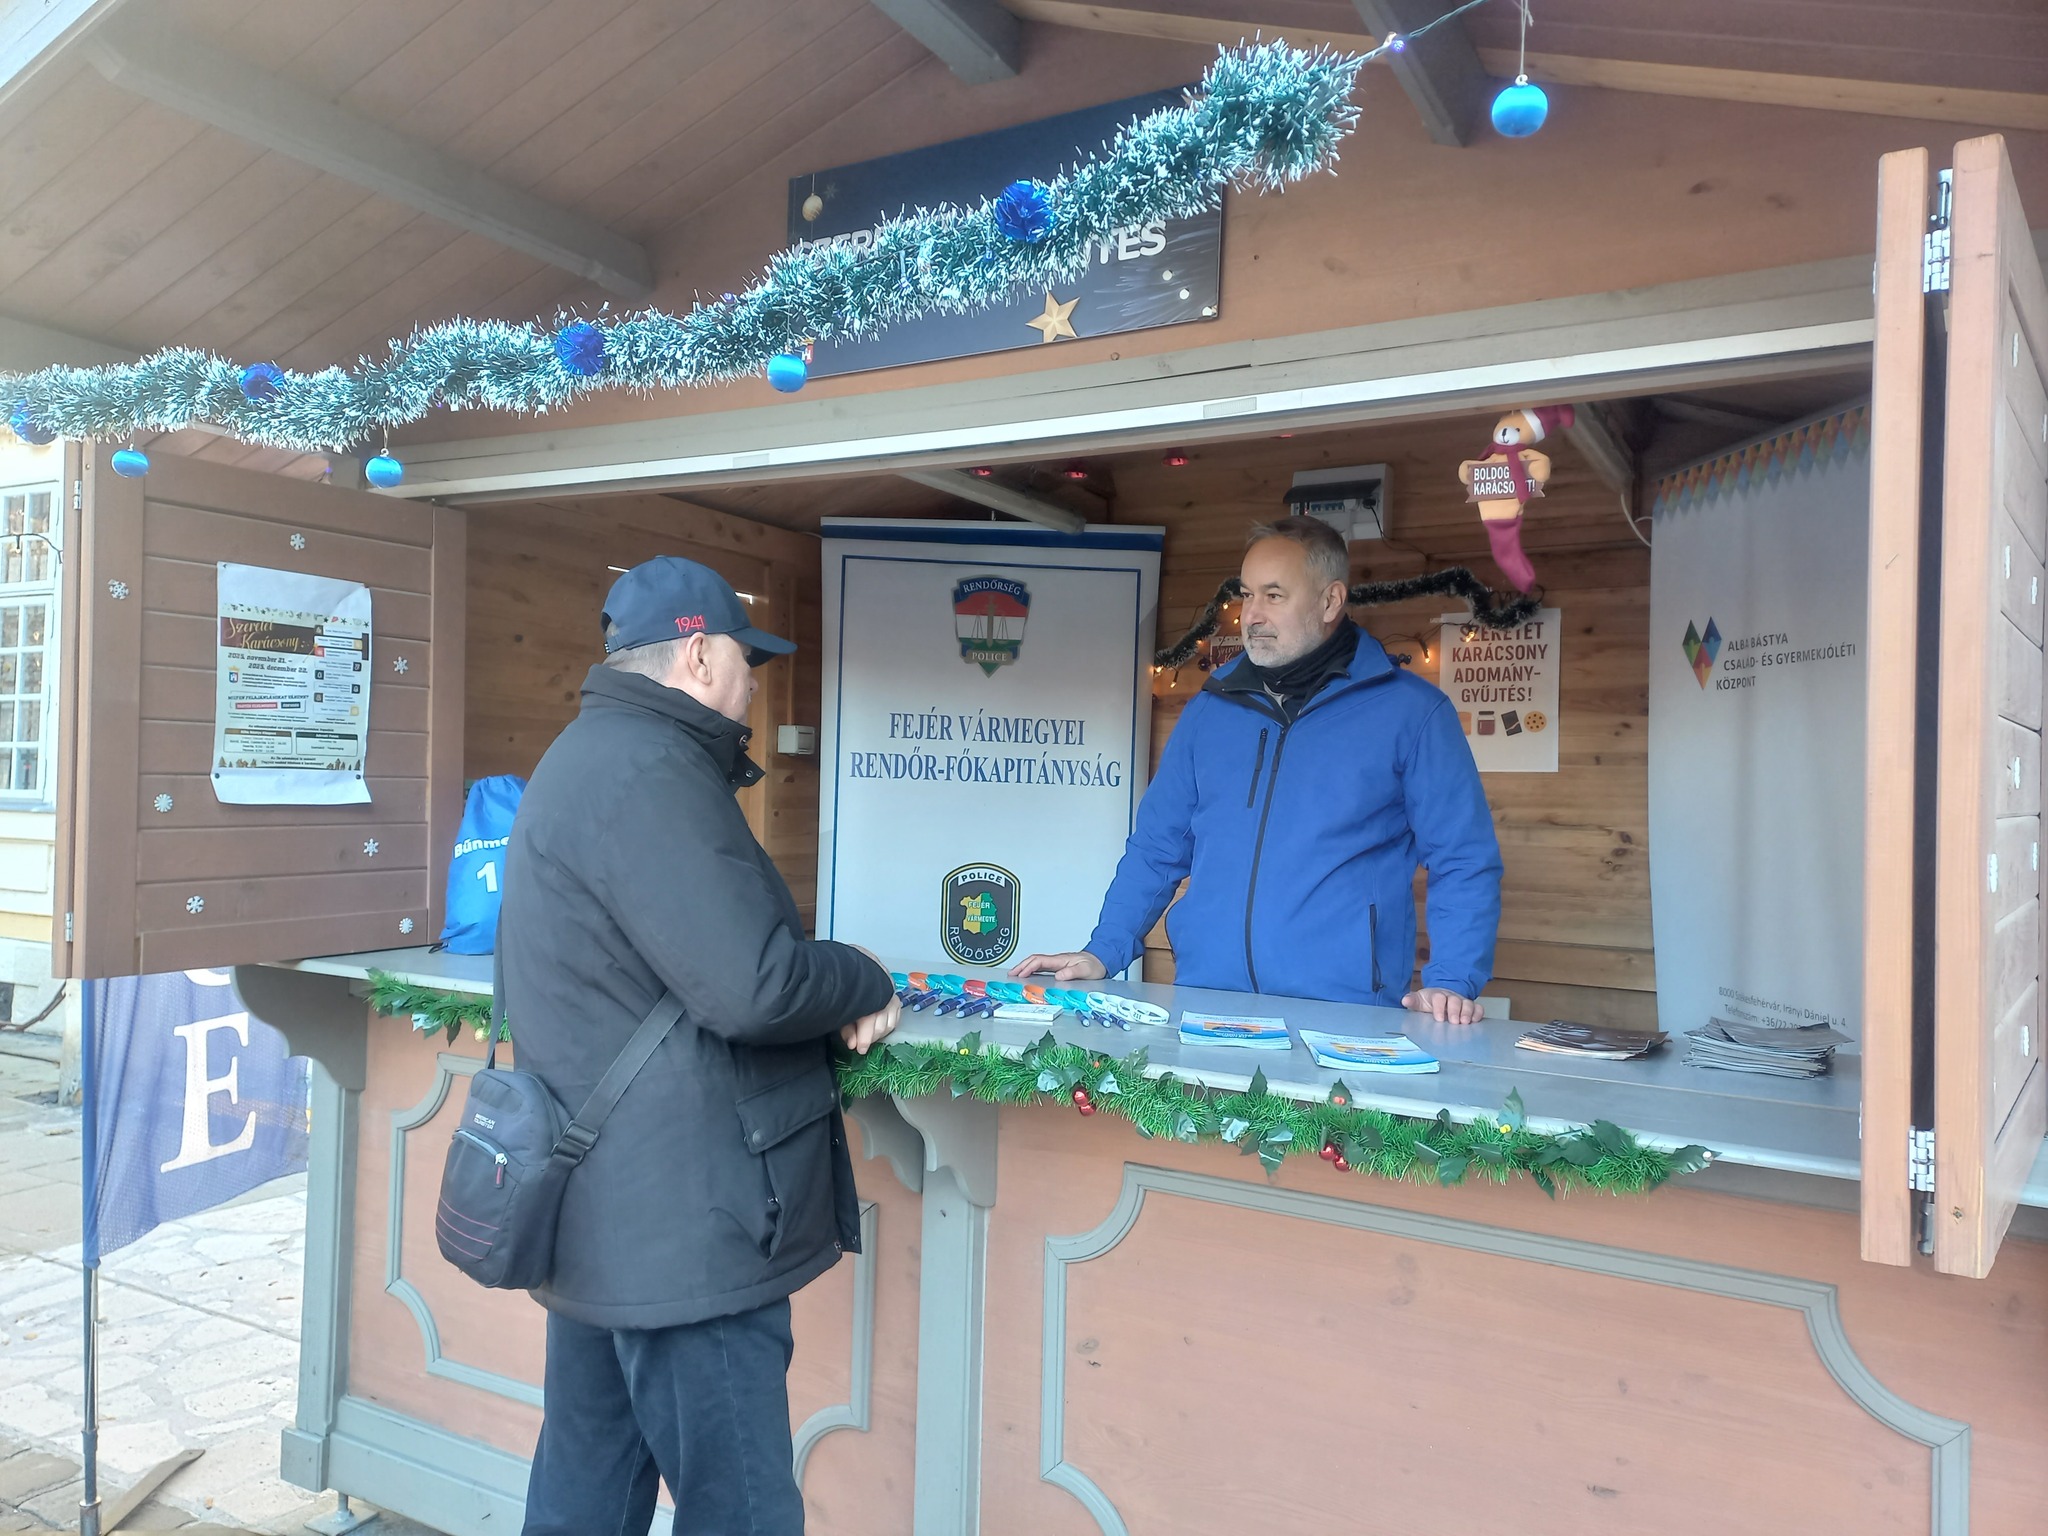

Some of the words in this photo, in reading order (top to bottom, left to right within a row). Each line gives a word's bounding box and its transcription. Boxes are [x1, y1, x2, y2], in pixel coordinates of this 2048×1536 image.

[1474, 466, 1510, 481] BOLDOG
[1474, 479, 1537, 495] KARÁCSOT!
[963, 579, 1021, 595] RENDŐRSÉG
[674, 615, 706, 633] 1941
[972, 652, 1007, 662] POLICE
[1452, 643, 1548, 663] KARÁCSONY
[1761, 652, 1773, 667] ÉS
[1776, 642, 1856, 665] GYERMEKJÓLÉTI
[1454, 663, 1541, 683] ADOMÁNY-
[1716, 675, 1756, 691] KÖZPONT
[1461, 685, 1532, 703] GYŰJTÉS!
[888, 707, 953, 742] FEJÉR
[957, 708, 1086, 747] VÁRMEGYEI
[849, 746, 1122, 788] RENDŐR-FŐKAPITÁNYSÁG
[454, 836, 510, 859] Bűnme
[476, 861, 498, 893] 1
[961, 872, 1003, 884] POLICE
[968, 900, 990, 909] FEJÉR
[967, 915, 996, 923] VÁRMEGYE
[949, 927, 1011, 960] RENDŐRSÉG
[1804, 1009, 1830, 1024] Dániel
